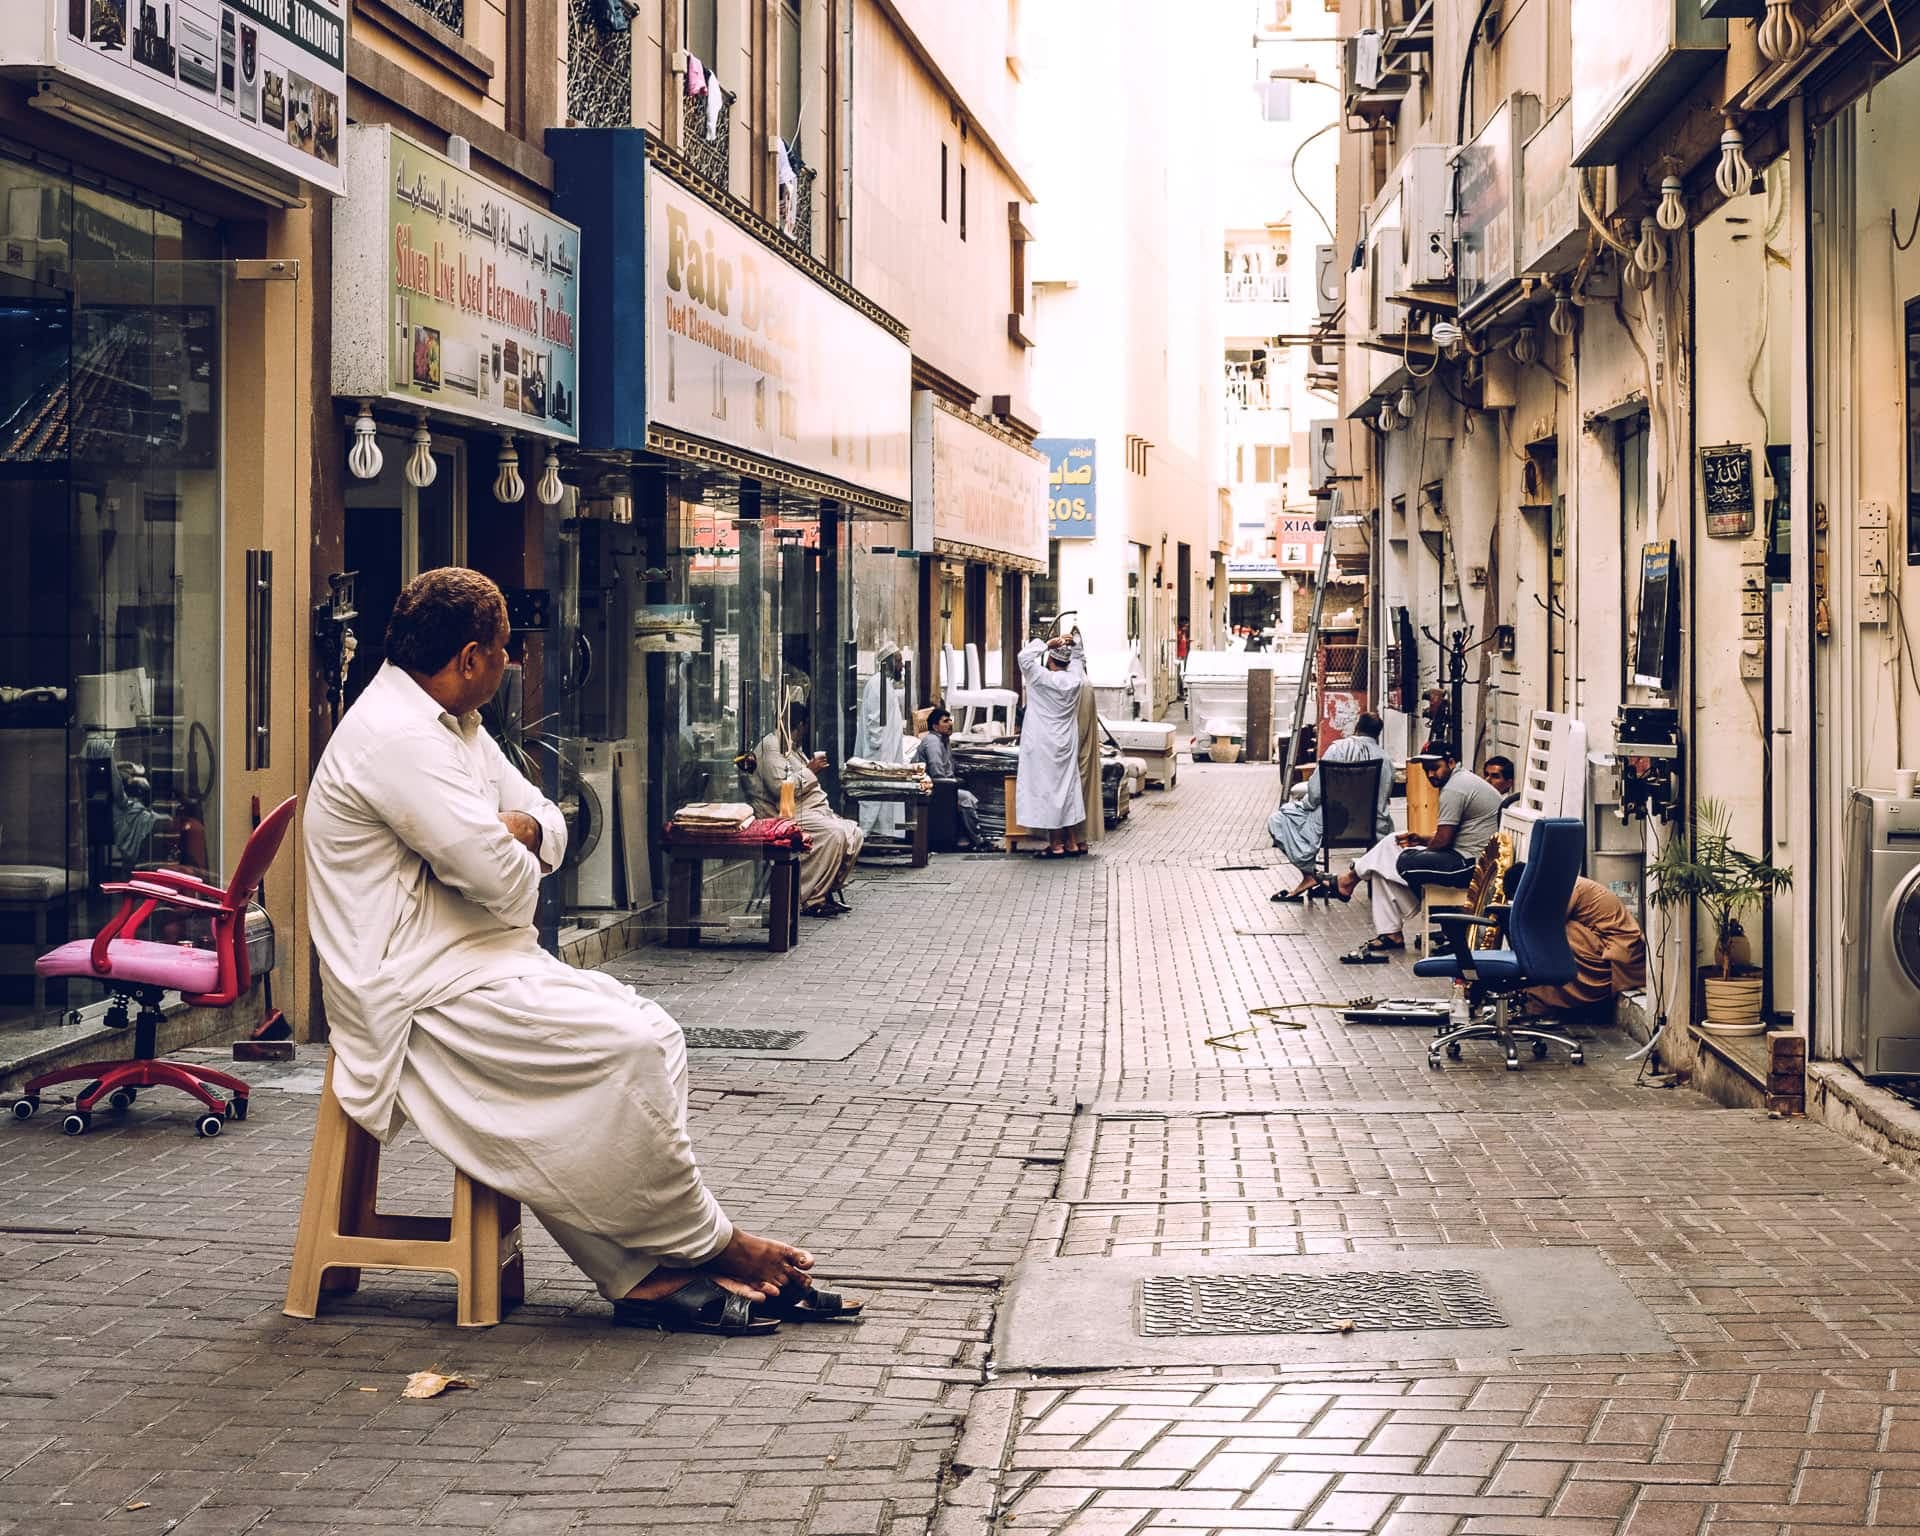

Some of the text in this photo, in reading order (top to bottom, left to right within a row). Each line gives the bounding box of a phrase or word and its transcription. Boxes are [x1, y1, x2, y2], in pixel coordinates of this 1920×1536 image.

[293, 1, 339, 59] TRADING
[396, 159, 447, 224] المستعملة
[666, 203, 733, 317] Fair
[666, 295, 687, 336] Used
[1048, 457, 1092, 493] صاب
[1284, 520, 1313, 531] XIA
